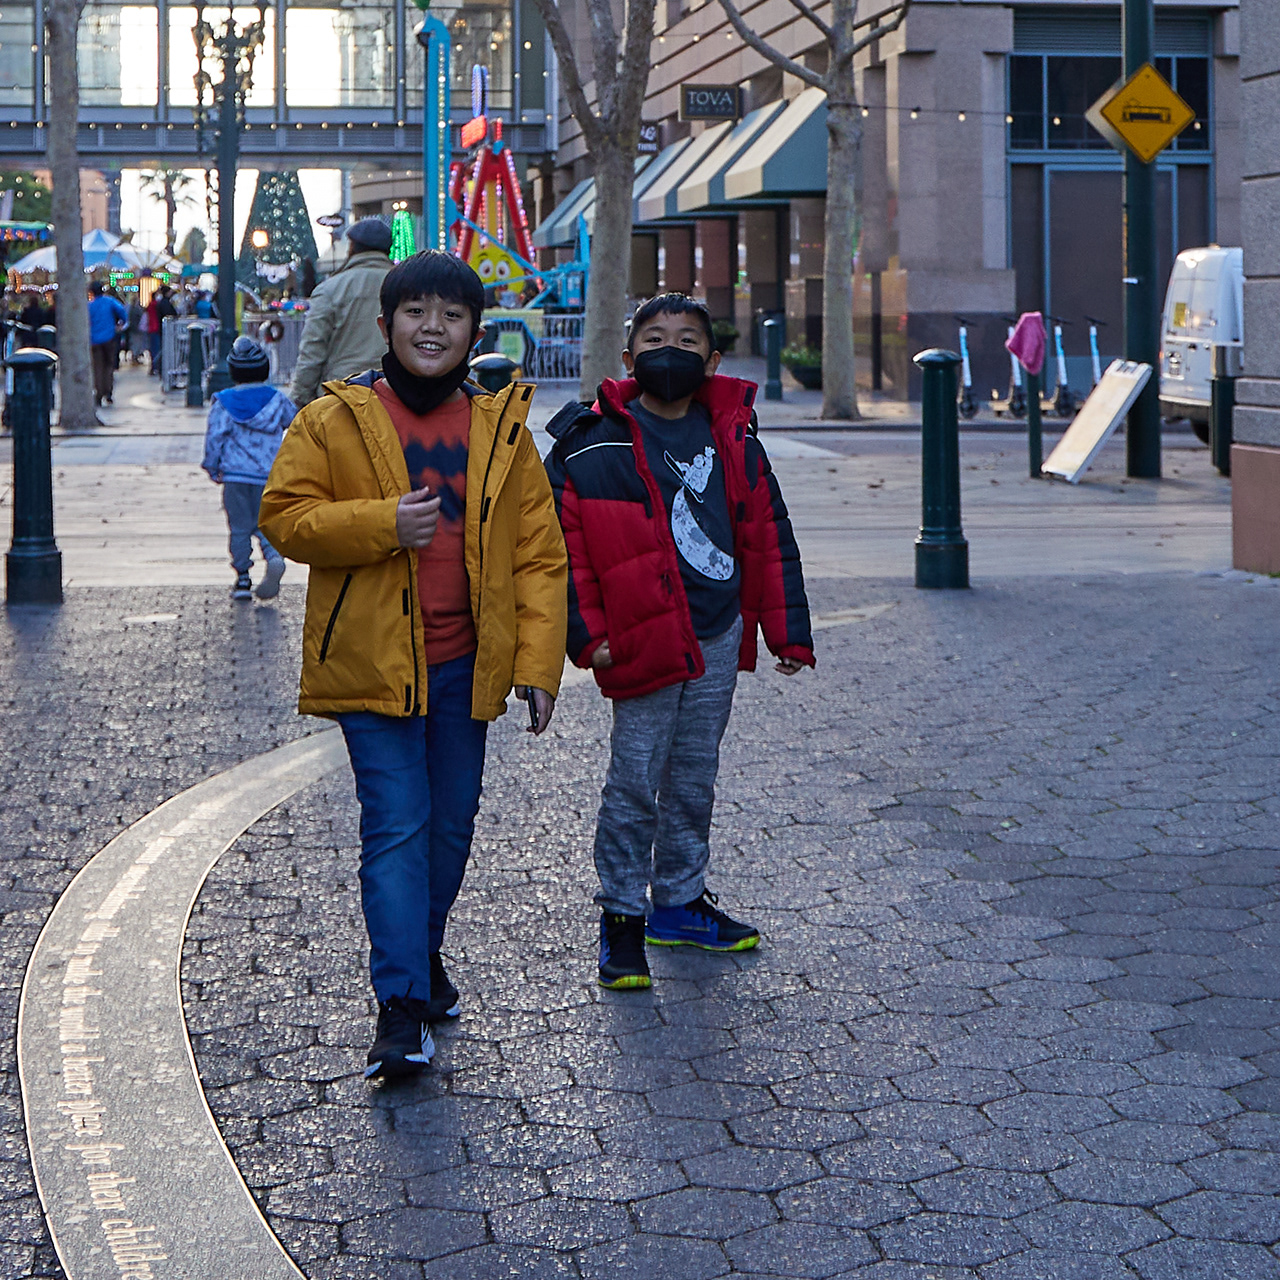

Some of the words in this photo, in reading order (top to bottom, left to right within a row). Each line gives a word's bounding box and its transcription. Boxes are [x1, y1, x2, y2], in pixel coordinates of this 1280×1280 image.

[687, 91, 732, 105] TOVA
[62, 955, 104, 984] make
[62, 985, 102, 1005] the
[60, 1006, 100, 1041] world
[60, 1043, 87, 1054] a
[62, 1056, 105, 1095] better
[57, 1100, 107, 1137] place
[64, 1143, 125, 1166] for
[86, 1172, 137, 1210] their
[101, 1218, 168, 1280] childre
